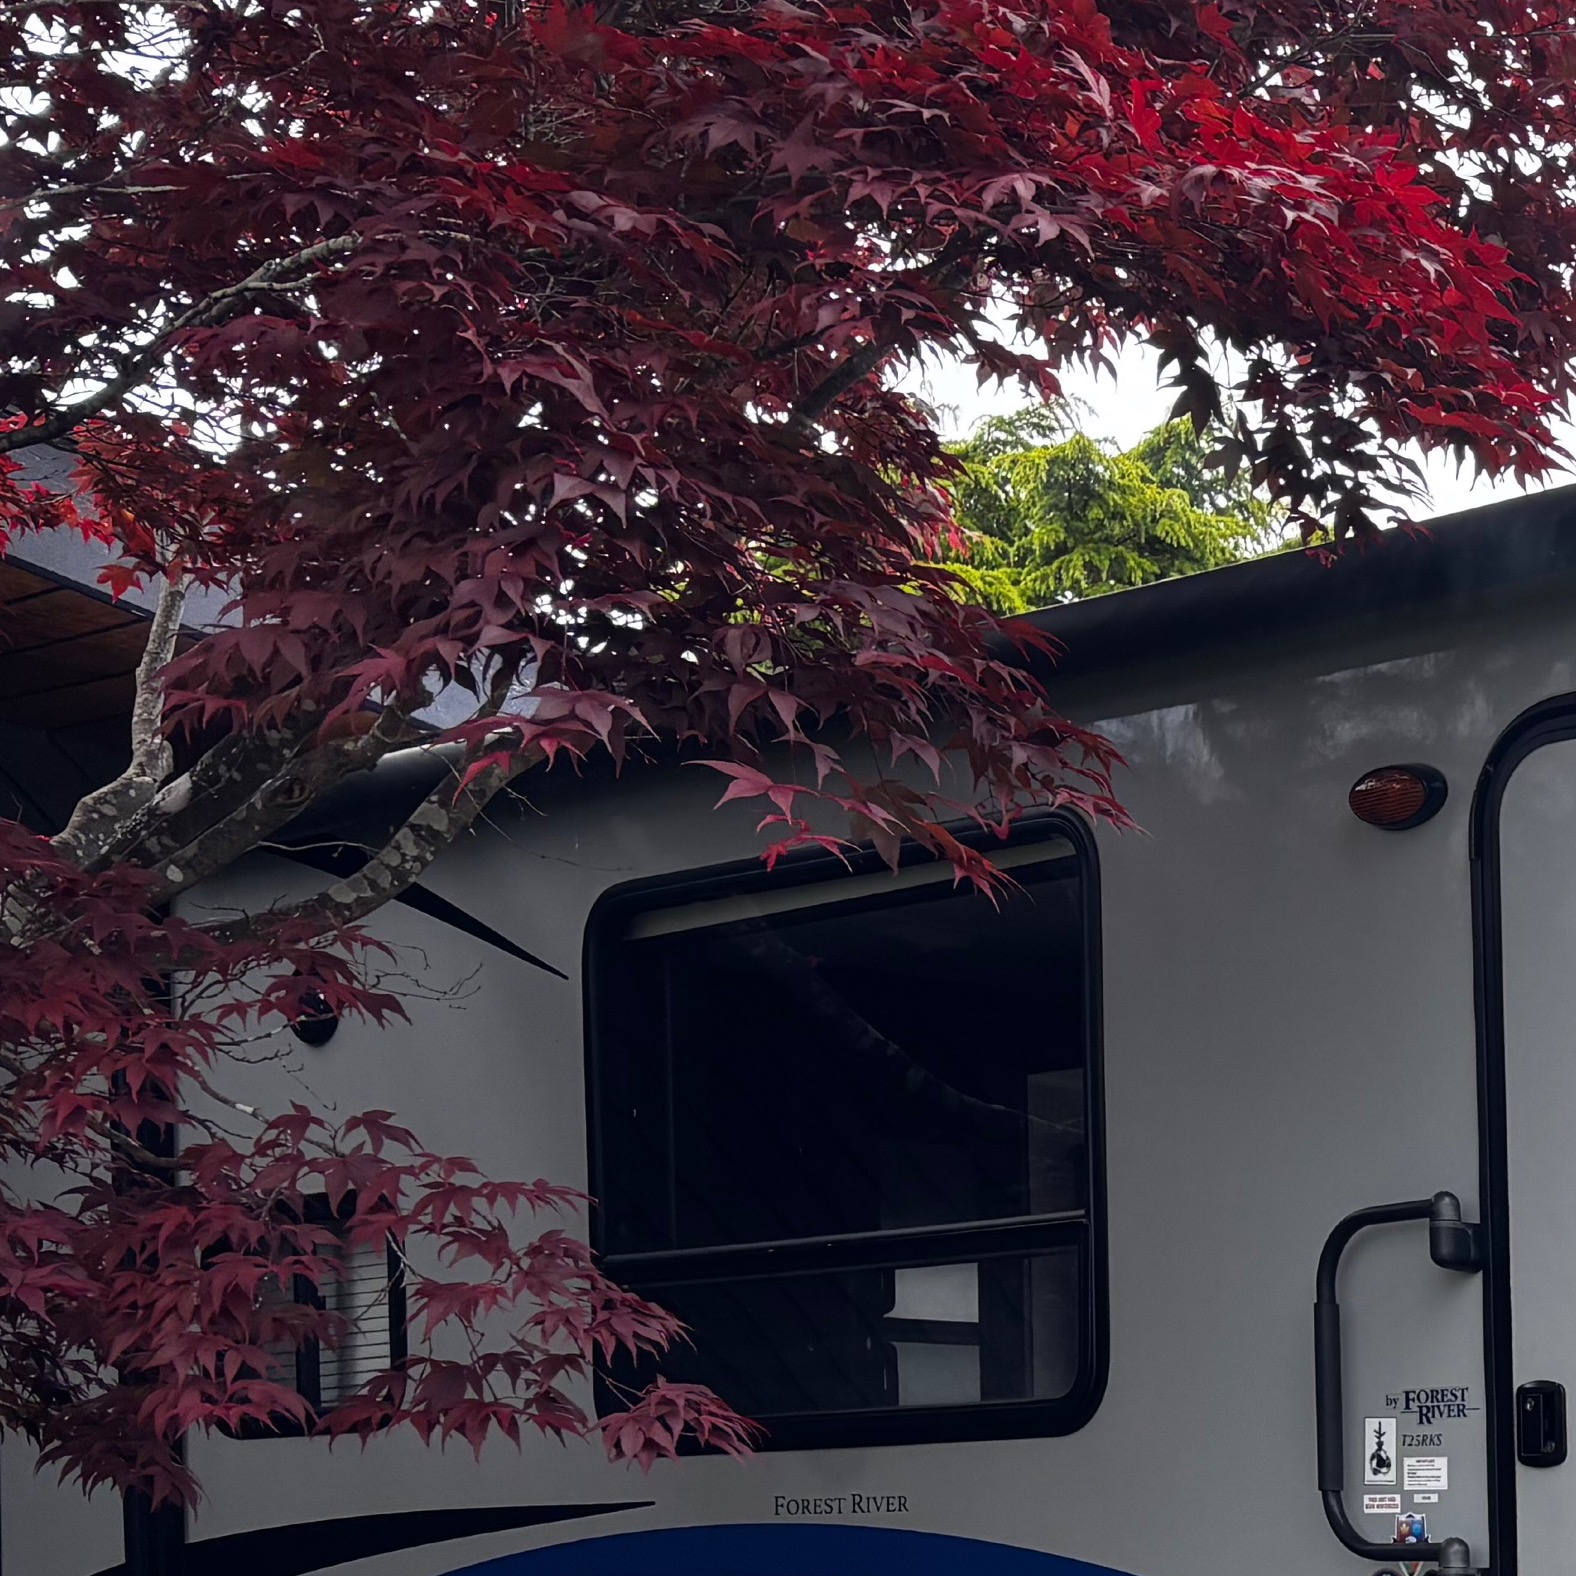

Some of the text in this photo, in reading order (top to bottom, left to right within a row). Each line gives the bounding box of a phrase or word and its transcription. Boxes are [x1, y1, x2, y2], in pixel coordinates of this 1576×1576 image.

[1385, 1386, 1469, 1411] by FOREST
[1416, 1403, 1468, 1425] RIVER
[1401, 1433, 1443, 1447] T25RKS
[774, 1493, 909, 1516] FOREST RIVER
